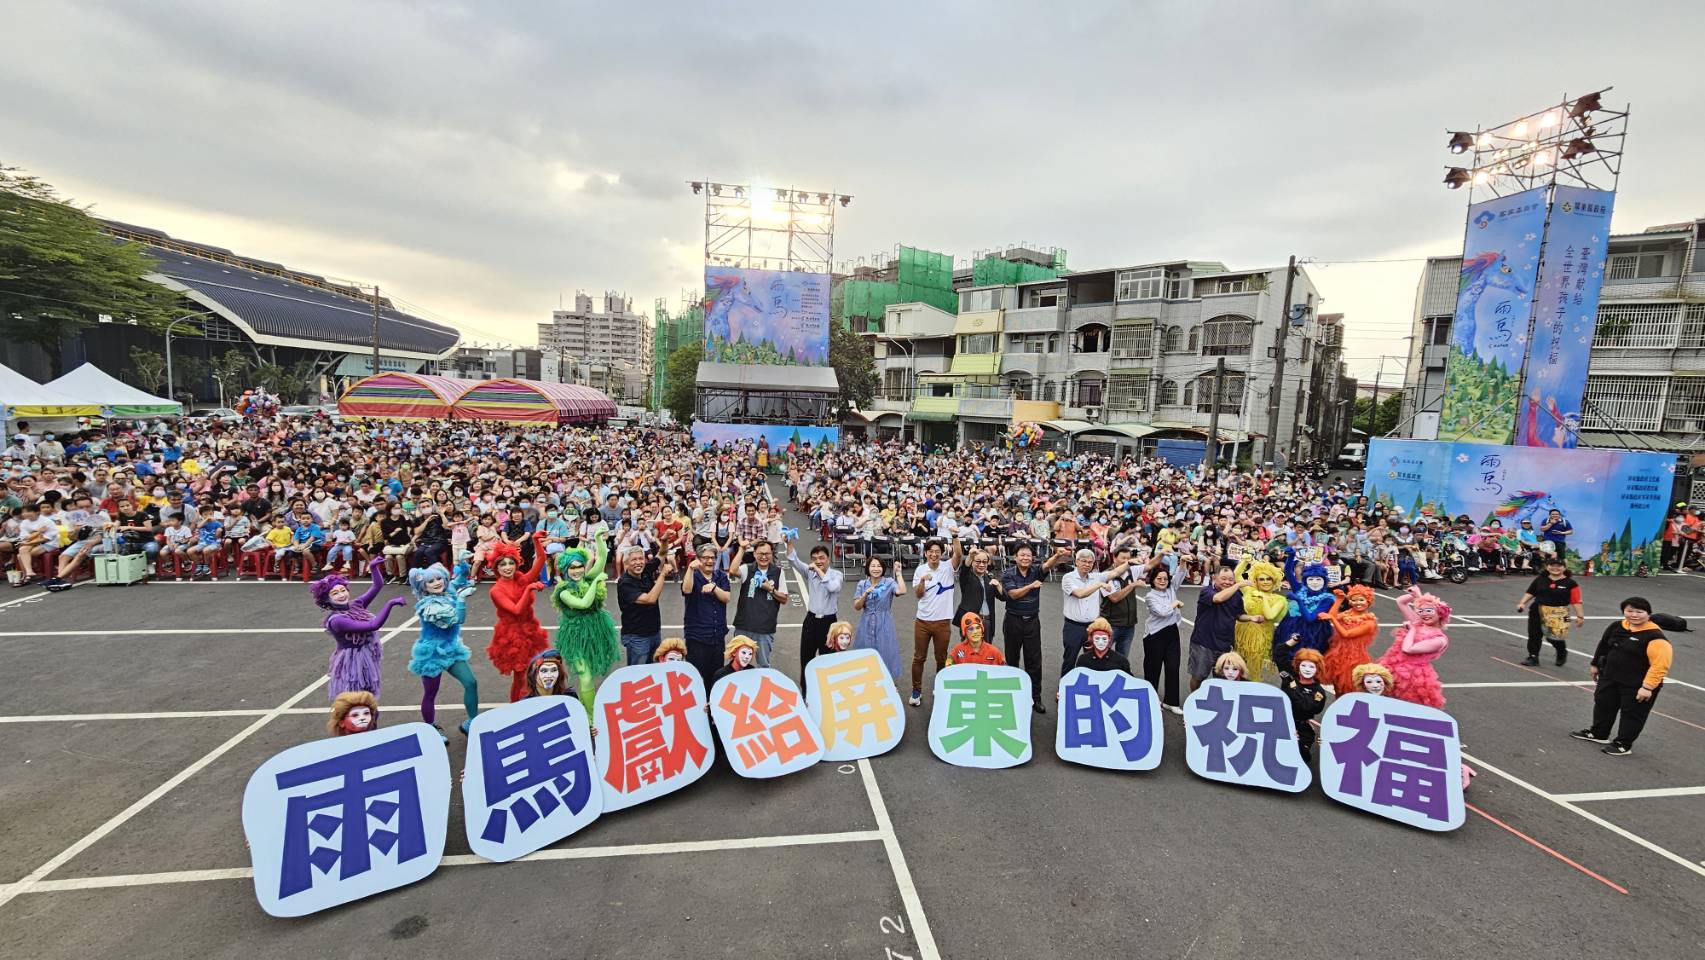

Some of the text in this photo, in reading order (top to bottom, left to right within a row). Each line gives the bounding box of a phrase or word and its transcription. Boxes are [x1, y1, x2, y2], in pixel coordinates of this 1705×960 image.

[1548, 244, 1574, 365] 全世界孩子的祝福
[1573, 247, 1590, 306] 臺灣獻給
[1489, 300, 1513, 343] 雨馬
[1475, 454, 1503, 495] 雨馬
[275, 656, 1454, 900] 雨 馬 獻 給 屏 東 的 祝 福
